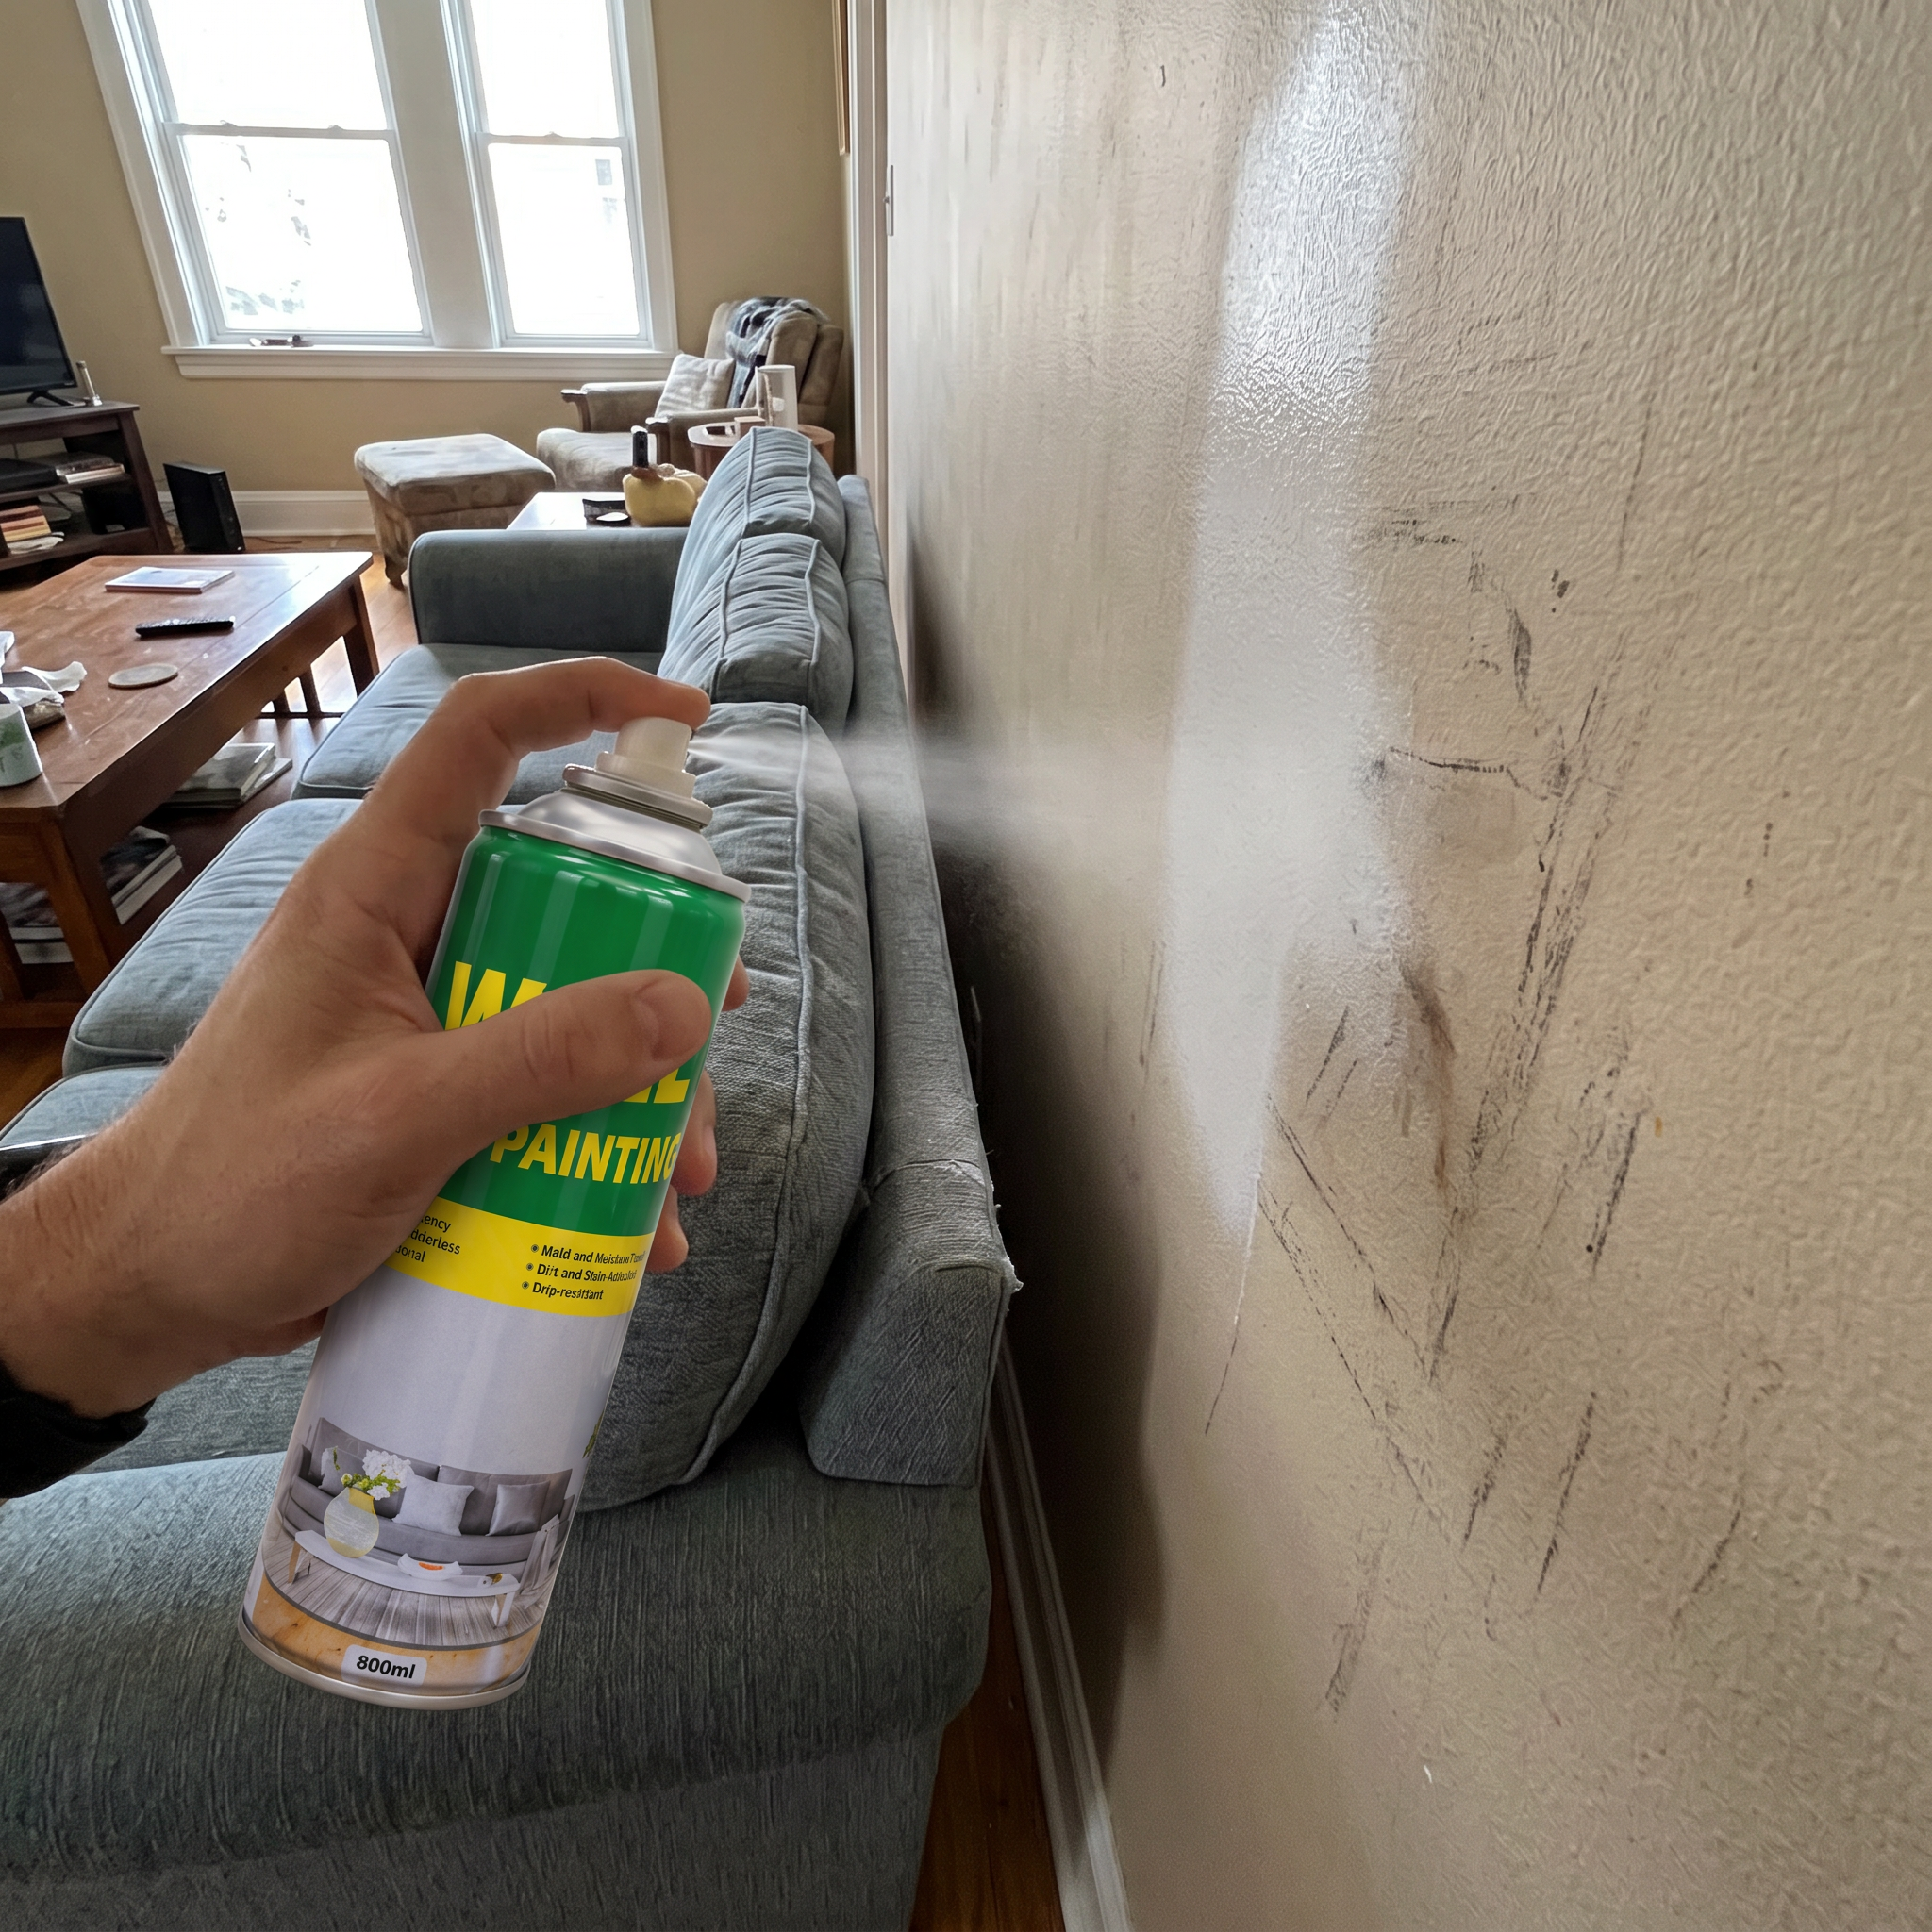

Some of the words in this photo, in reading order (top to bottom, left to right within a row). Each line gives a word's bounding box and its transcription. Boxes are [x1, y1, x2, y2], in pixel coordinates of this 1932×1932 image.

[490, 1124, 681, 1185] PAINTING
[421, 1215, 452, 1233] ency
[409, 1229, 460, 1255] dderless
[574, 1252, 594, 1263] and
[561, 1269, 583, 1280] and
[357, 1655, 416, 1679] 800ml
